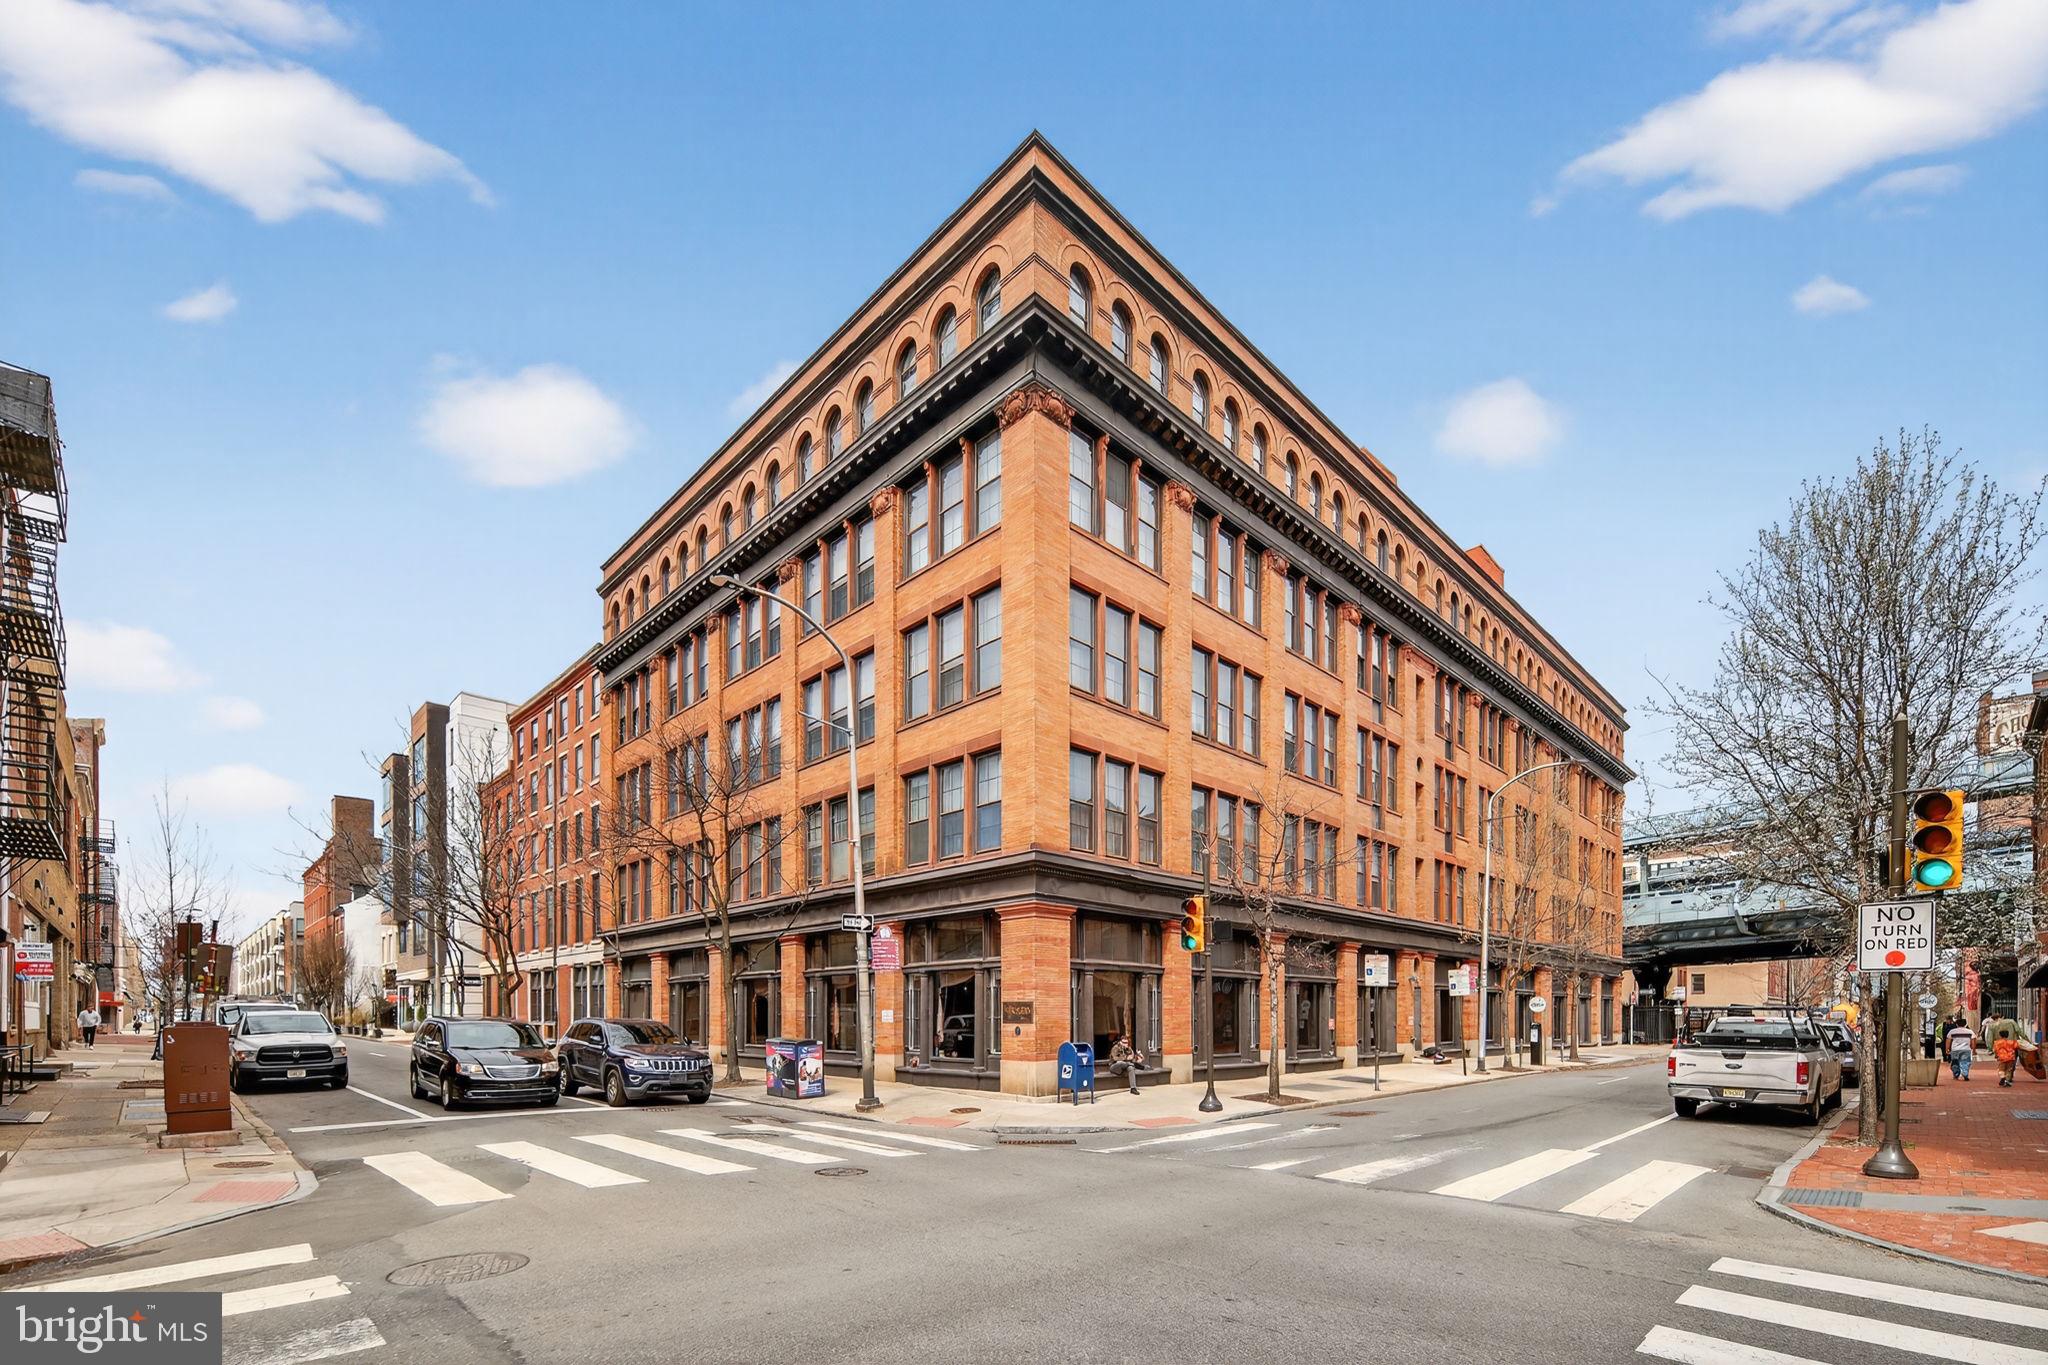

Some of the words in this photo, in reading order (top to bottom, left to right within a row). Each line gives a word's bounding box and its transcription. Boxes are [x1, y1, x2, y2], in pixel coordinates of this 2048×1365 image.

[1877, 906, 1915, 923] NO
[1870, 924, 1922, 937] TURN
[1864, 938, 1888, 951] ON
[1896, 937, 1928, 950] RED
